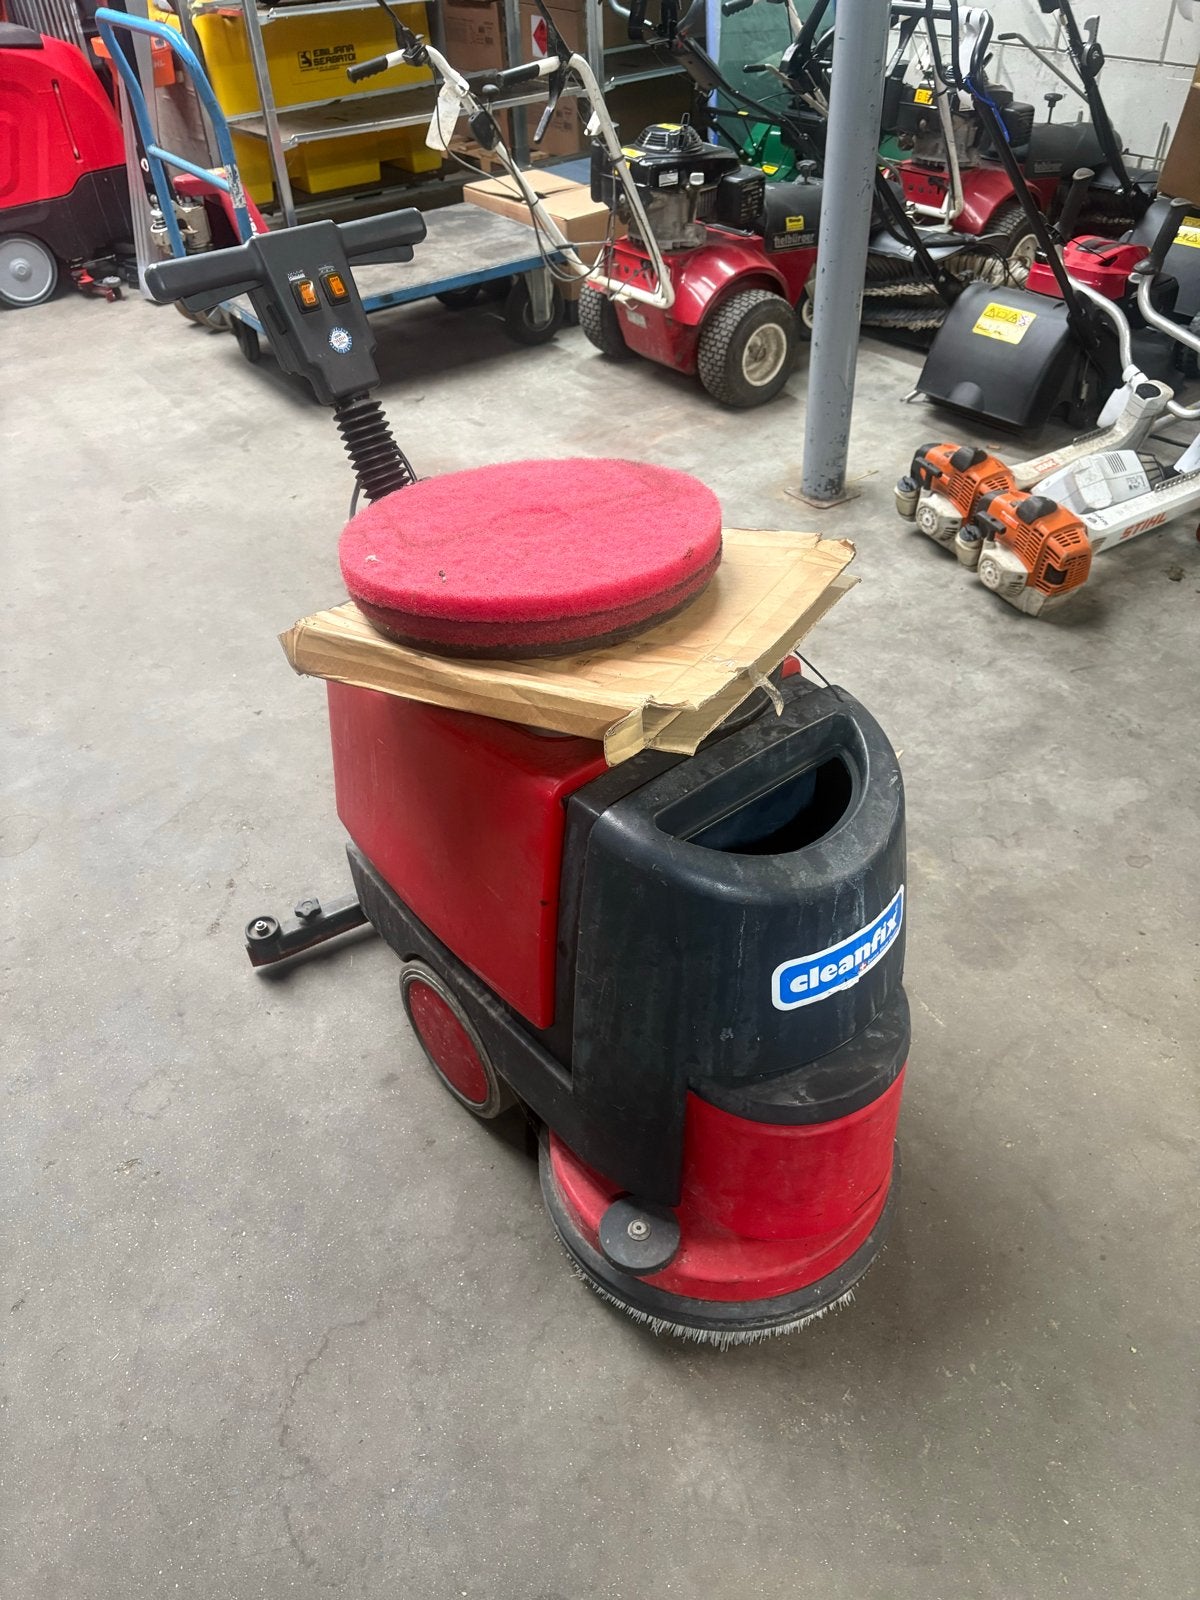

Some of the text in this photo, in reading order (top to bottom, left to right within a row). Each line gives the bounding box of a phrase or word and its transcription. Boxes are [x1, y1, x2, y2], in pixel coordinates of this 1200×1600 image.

[313, 44, 355, 57] EMILIANA
[313, 54, 356, 66] SERBATOI
[1119, 510, 1168, 541] STIHL
[789, 903, 899, 993] cleanfix
